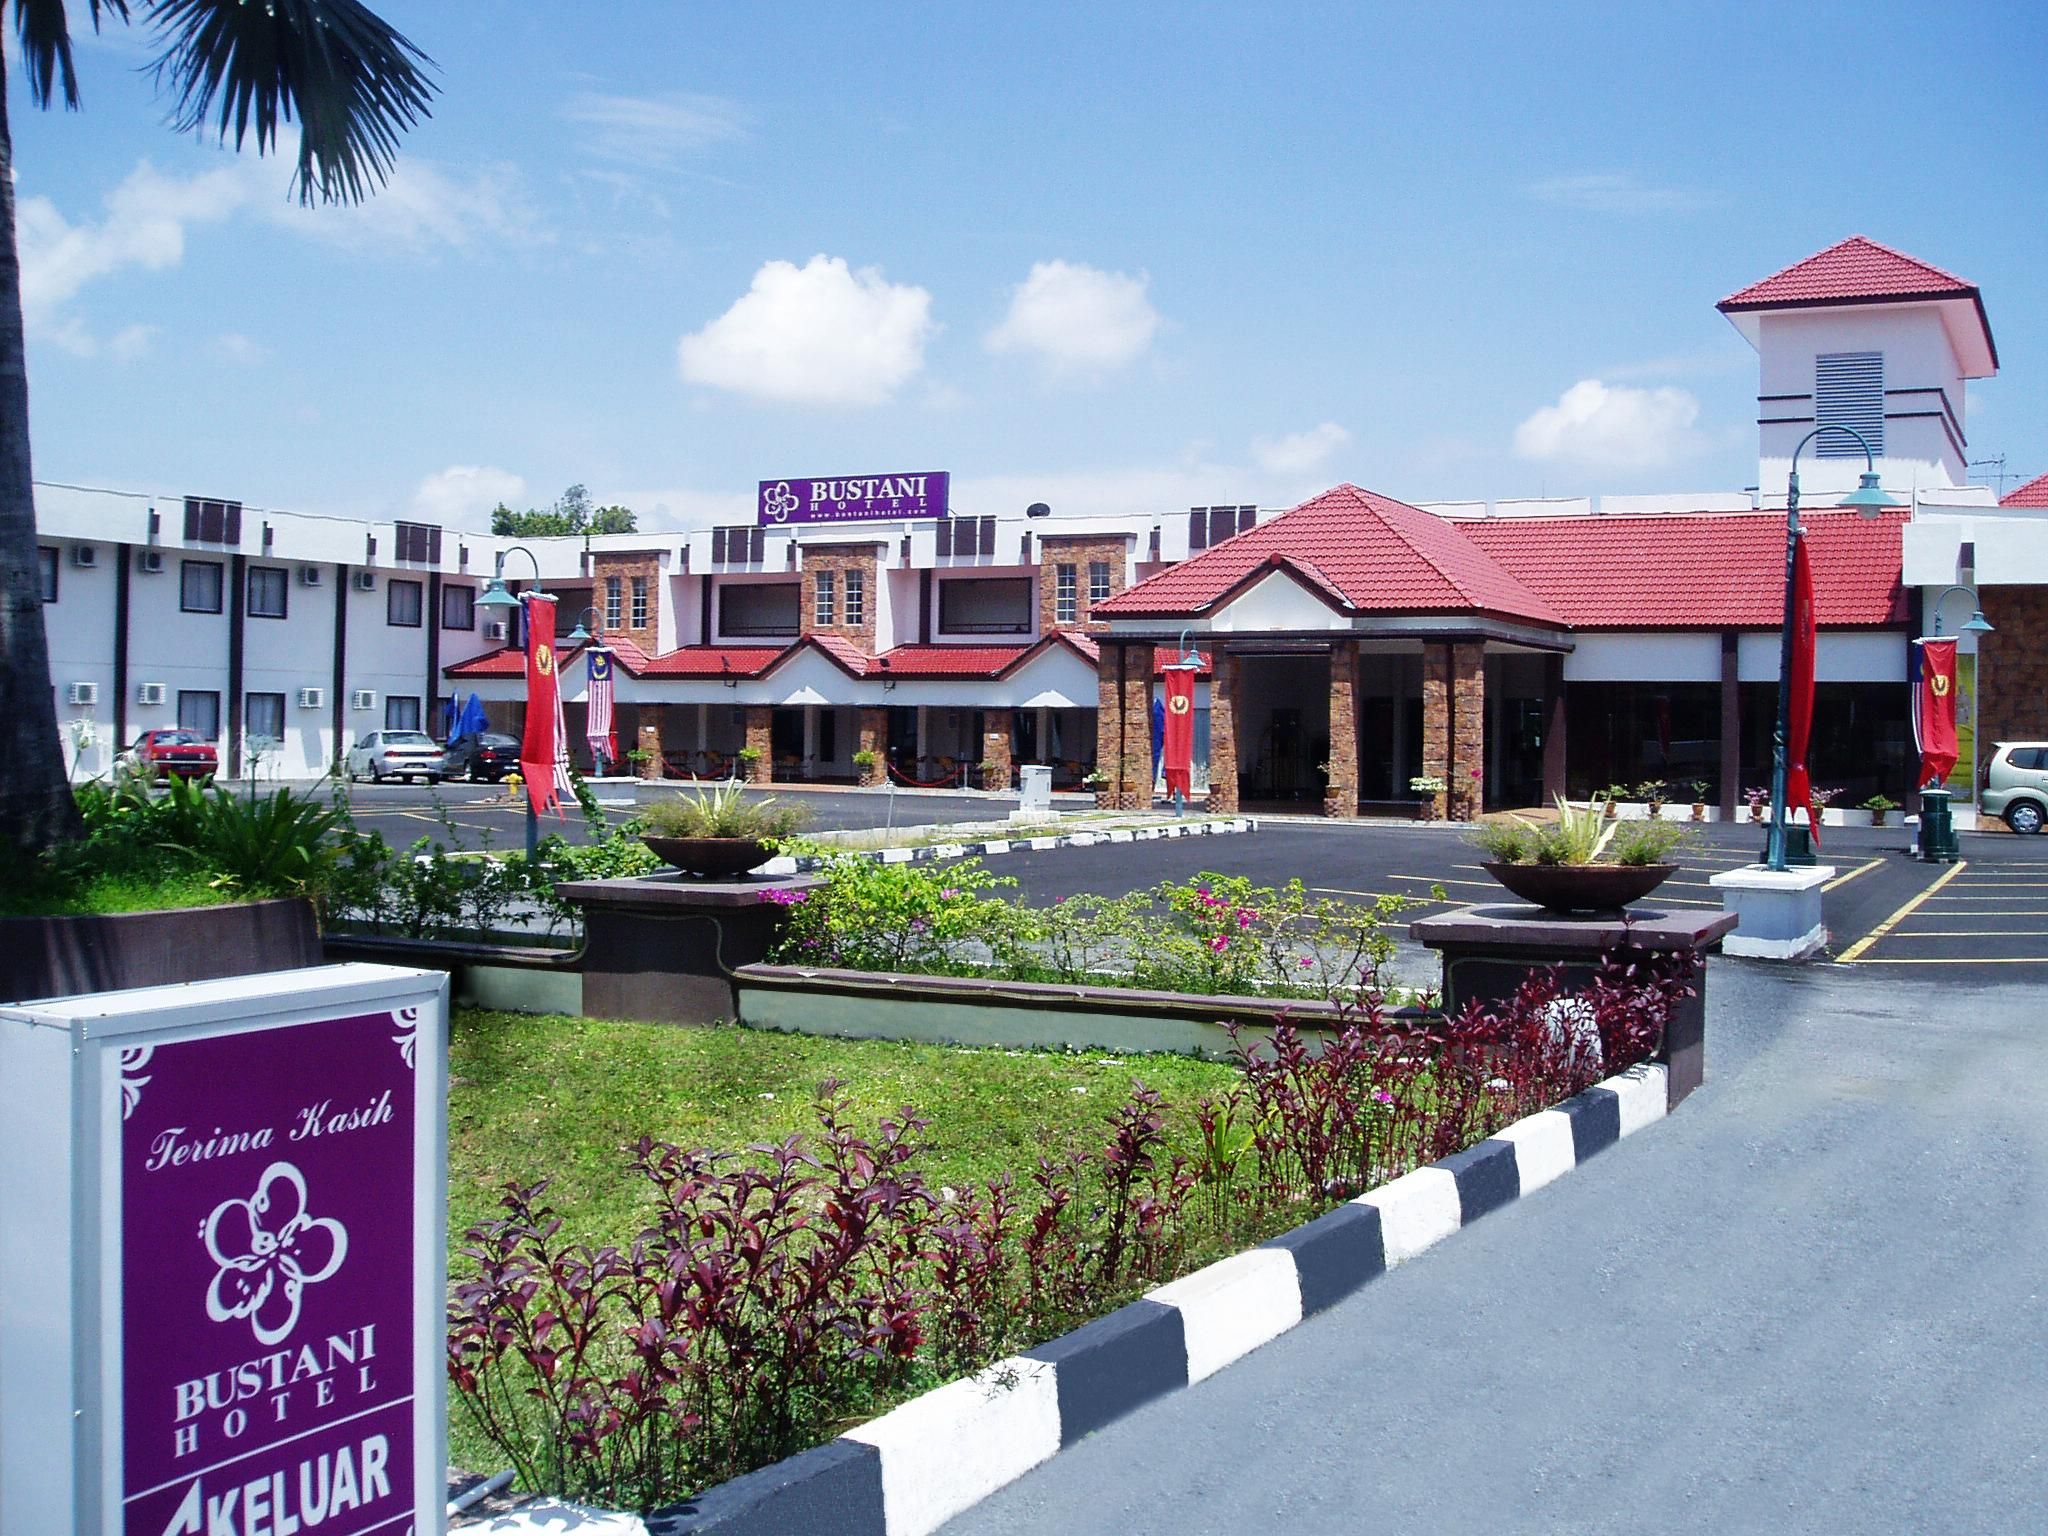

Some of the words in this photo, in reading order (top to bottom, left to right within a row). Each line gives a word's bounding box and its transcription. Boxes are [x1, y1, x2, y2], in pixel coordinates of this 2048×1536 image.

[810, 476, 928, 501] BUSTANI
[810, 497, 928, 511] HOTEL
[145, 1126, 275, 1172] Terima
[289, 1088, 395, 1142] Kasih
[174, 1323, 376, 1423] BUSTANI
[174, 1366, 377, 1459] HOTEL
[206, 1434, 392, 1536] KELUAR
